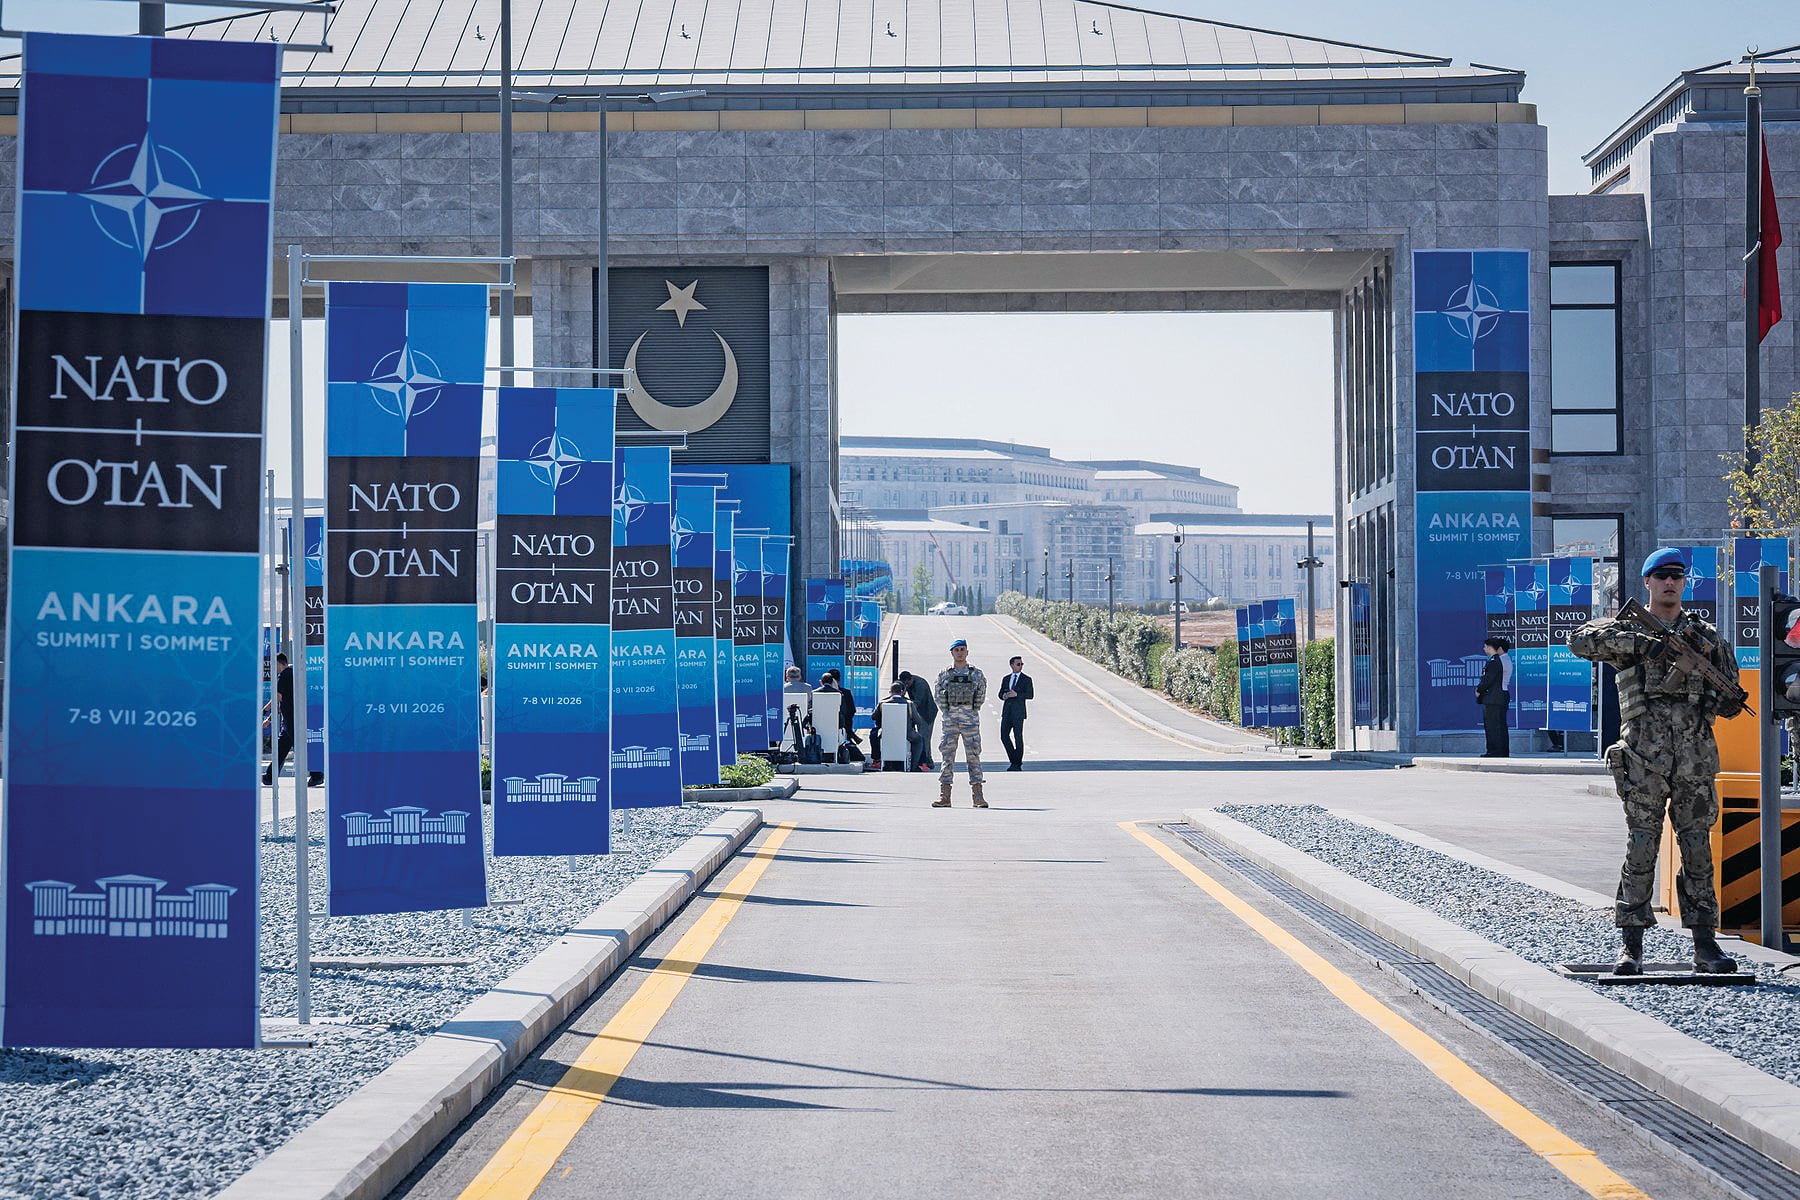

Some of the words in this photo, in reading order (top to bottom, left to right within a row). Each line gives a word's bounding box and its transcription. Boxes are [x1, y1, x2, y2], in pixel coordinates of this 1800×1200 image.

[50, 354, 228, 405] NATO
[1431, 392, 1515, 417] NATO
[1431, 445, 1516, 470] OTAN
[47, 458, 228, 510] OTAN
[348, 482, 461, 512] NATO
[1428, 512, 1520, 528] ANKARA
[1428, 533, 1468, 541] SUMMIT
[1477, 533, 1520, 541] SOMMET
[511, 534, 595, 556] NATO
[348, 548, 461, 578] OTAN
[613, 560, 659, 578] ATO
[1445, 571, 1461, 580] 7-8
[1464, 572, 1477, 580] VII
[673, 579, 703, 594] TO
[511, 582, 595, 604] OTAN
[36, 591, 233, 626] ANKARA
[305, 597, 324, 609] NA
[611, 597, 661, 615] TAN
[734, 604, 756, 615] TO
[1742, 605, 1760, 616] NA
[674, 610, 704, 625] AN
[1555, 611, 1587, 621] NATO
[305, 623, 325, 635] OT
[812, 626, 840, 635] NATO
[1554, 629, 1571, 639] OT
[1742, 627, 1760, 638] OT
[36, 631, 120, 649] SUMMIT
[140, 634, 233, 652] SOMMET
[344, 631, 465, 651] ANKARA
[811, 641, 840, 650] OTAN
[1269, 638, 1292, 646] NATO
[507, 643, 598, 658] ANKARA
[612, 644, 666, 657] NKARA
[678, 649, 707, 659] ARA
[344, 656, 396, 667] SUMMIT
[408, 656, 465, 666] SOMMET
[632, 658, 666, 666] SOMMET
[734, 653, 759, 661] KARA
[507, 662, 546, 670] SUMMIT
[555, 662, 598, 670] SOMMET
[522, 697, 538, 705] 7-8
[541, 697, 554, 705] VII
[557, 697, 582, 705] 2026
[365, 703, 386, 714] 7-8
[390, 703, 408, 713] VII
[412, 703, 445, 713] 2026
[68, 708, 102, 725] 7-8
[108, 709, 136, 725] VII
[143, 710, 197, 727] 2026
